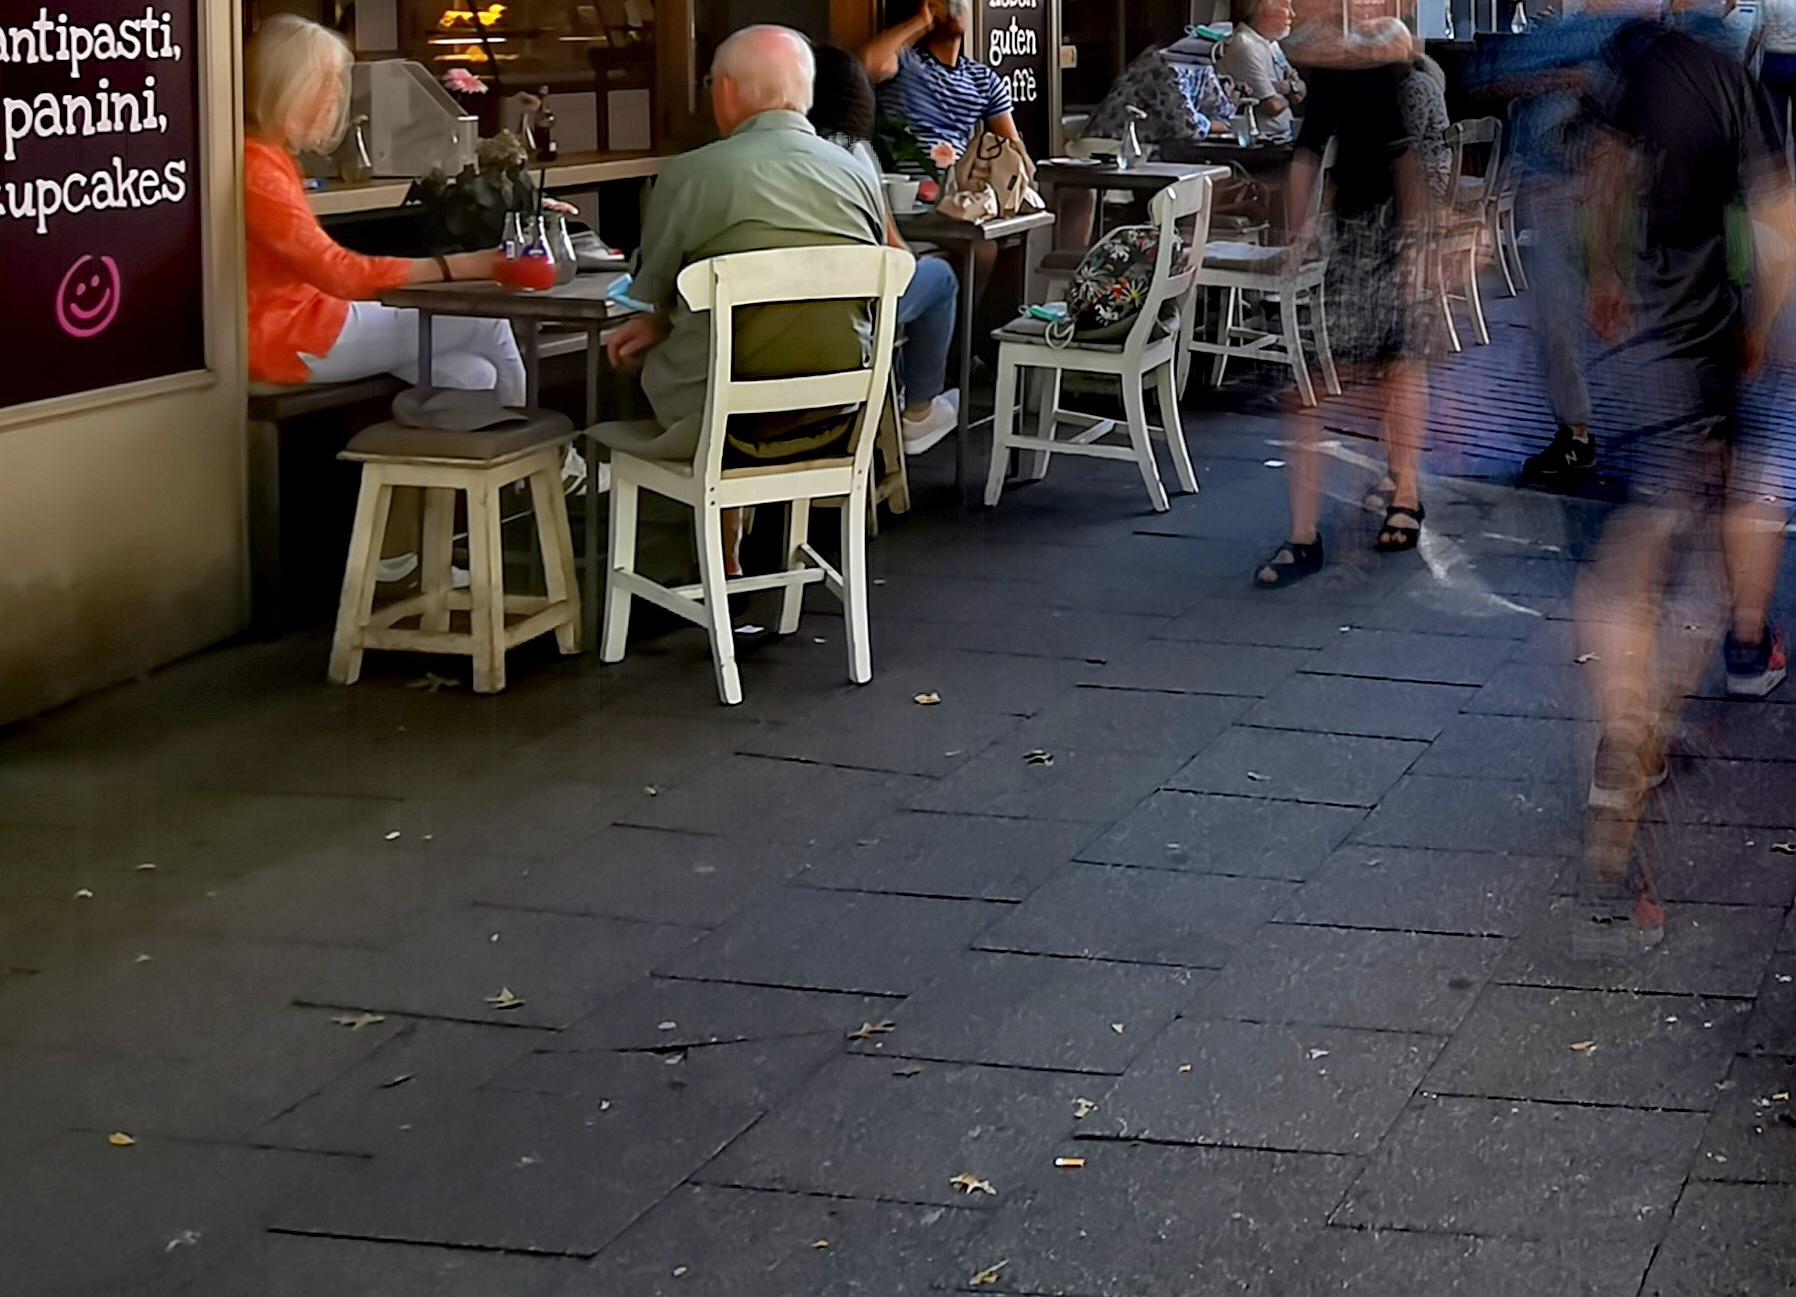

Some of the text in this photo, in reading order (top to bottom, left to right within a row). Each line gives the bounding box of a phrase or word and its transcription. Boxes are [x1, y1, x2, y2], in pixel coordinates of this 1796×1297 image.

[989, 16, 1036, 65] guten
[1001, 68, 1037, 102] affè
[3, 76, 168, 161] panini,
[0, 156, 186, 234] upcakes
